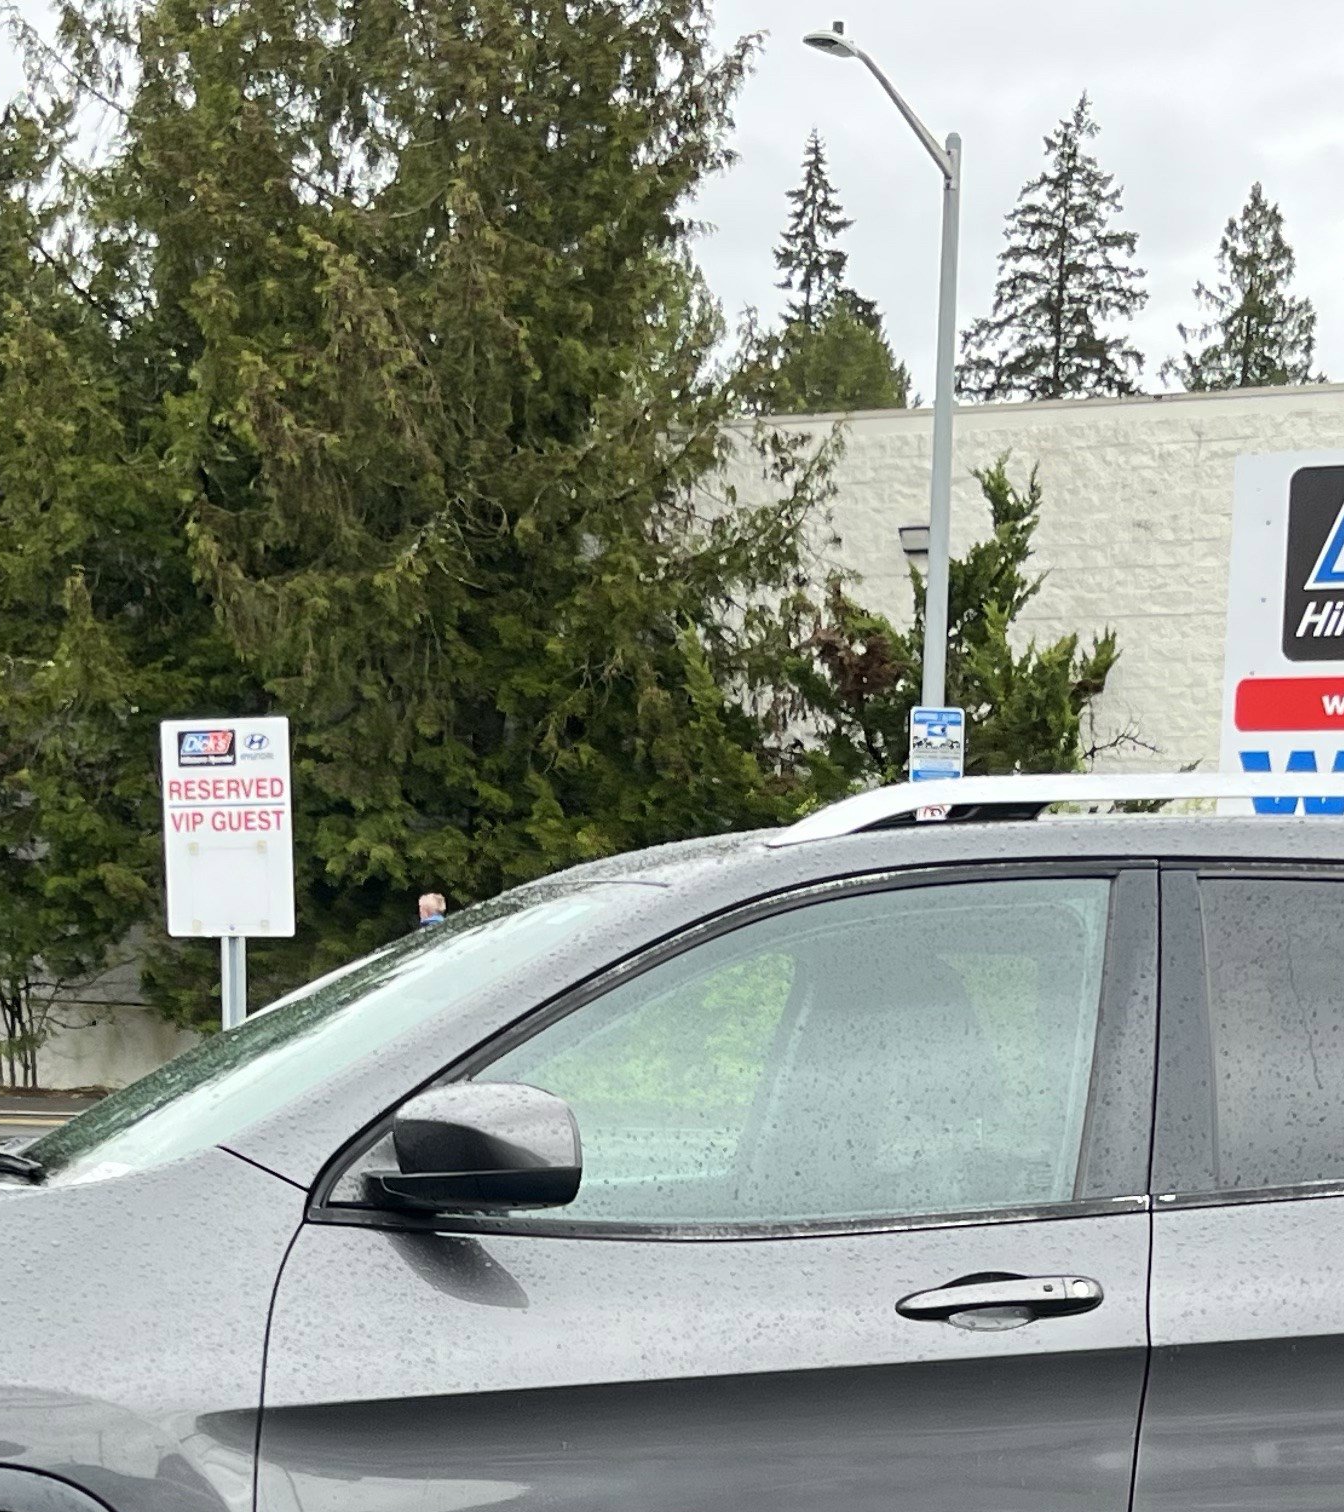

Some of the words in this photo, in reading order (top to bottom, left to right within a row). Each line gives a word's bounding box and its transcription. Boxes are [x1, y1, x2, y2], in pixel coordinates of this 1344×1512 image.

[168, 777, 284, 800] RESERVED
[171, 812, 204, 832] VIP
[211, 810, 285, 831] GUEST
